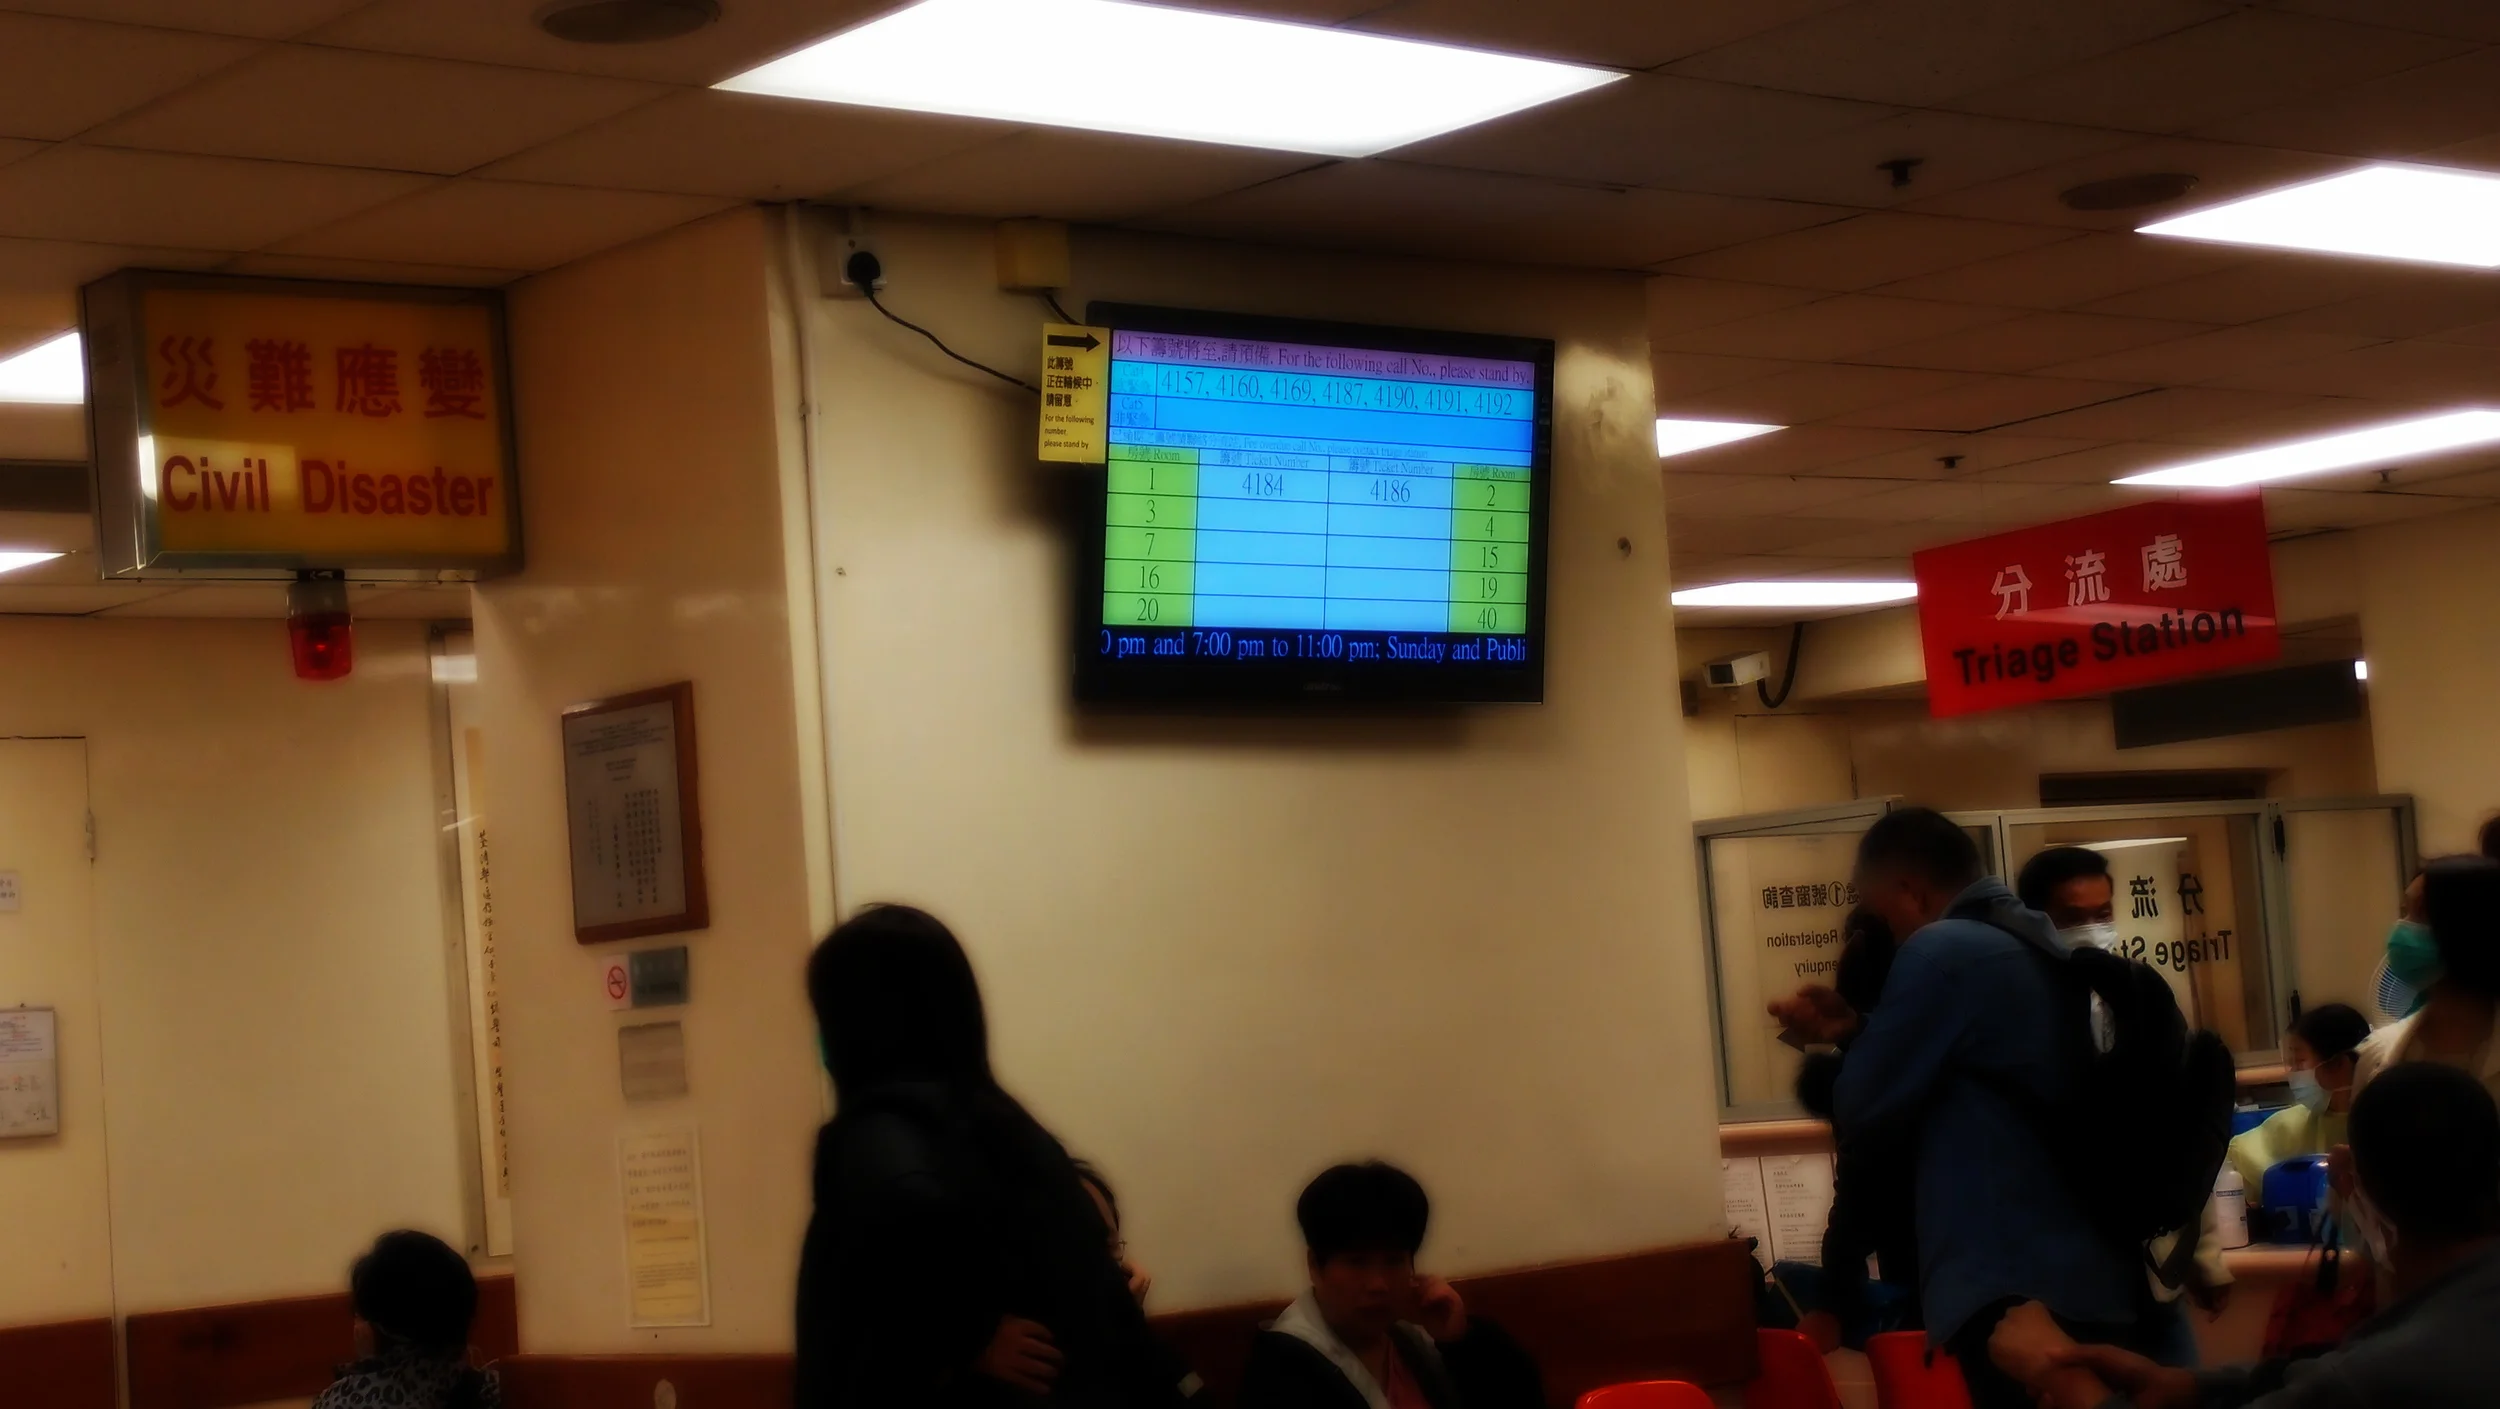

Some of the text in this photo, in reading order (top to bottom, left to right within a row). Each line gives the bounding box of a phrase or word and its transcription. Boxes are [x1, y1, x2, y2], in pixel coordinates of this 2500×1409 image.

[159, 334, 487, 421] 災難應變
[1278, 349, 1302, 367] For
[1303, 350, 1320, 368] the
[1326, 352, 1383, 375] following
[1386, 358, 1407, 375] call
[1411, 359, 1436, 378] No.,
[1440, 364, 1475, 381] please
[1479, 366, 1509, 381] stand
[1512, 368, 1530, 385] by.
[1161, 370, 1512, 416] 4157, 4160, 4169, 4187, 4190, 4191, 4192
[1045, 413, 1095, 426] For the following
[1043, 439, 1089, 450] please stand by
[1153, 448, 1181, 461] Room
[1245, 451, 1272, 467] Ticket
[1274, 452, 1309, 469] Number
[1373, 459, 1400, 474] Ticket
[1401, 460, 1434, 476] Number
[161, 454, 494, 517] Civil Disaster
[1242, 472, 1284, 497] 4184
[1492, 467, 1516, 481] Room
[1369, 478, 1411, 503] 4186
[1486, 484, 1496, 507] 2
[1145, 499, 1156, 523] 3
[1485, 515, 1495, 538] 4
[1144, 532, 1156, 557] 7
[1481, 545, 1499, 569] 15
[1139, 564, 1160, 590] 16
[1481, 576, 1498, 600] 19
[1990, 533, 2188, 621] 分流處
[1136, 597, 1159, 622] 20
[1477, 606, 1497, 631] 40
[1117, 636, 1146, 659] pm
[1153, 631, 1185, 656] and
[1192, 631, 1231, 656] 7:00
[1237, 638, 1264, 660] pm
[1272, 636, 1289, 657] to
[1297, 633, 1342, 658] 11:00
[1348, 640, 1380, 662] pm;
[1387, 635, 1446, 663] Sunday
[1452, 637, 1480, 660] and
[1486, 637, 1526, 661] Publi
[1952, 606, 2246, 687] Triage Station
